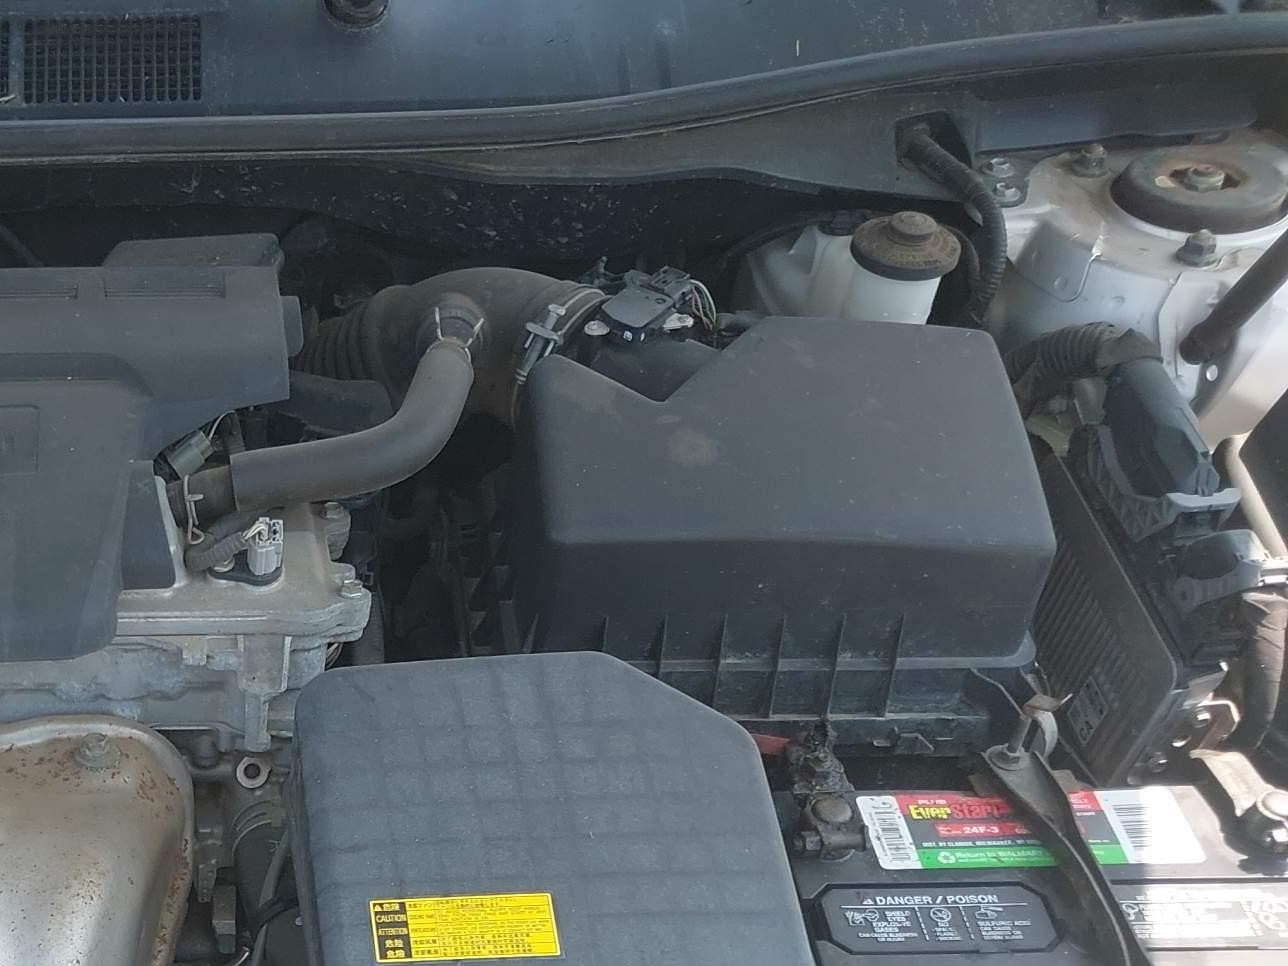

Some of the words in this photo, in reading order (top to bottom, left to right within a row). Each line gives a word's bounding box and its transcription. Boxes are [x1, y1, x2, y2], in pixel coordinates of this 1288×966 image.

[875, 895, 932, 905] DANGER
[936, 895, 943, 905] /
[946, 894, 999, 904] POISON
[375, 913, 407, 923] CAUTION
[378, 927, 409, 936] ATTENTION
